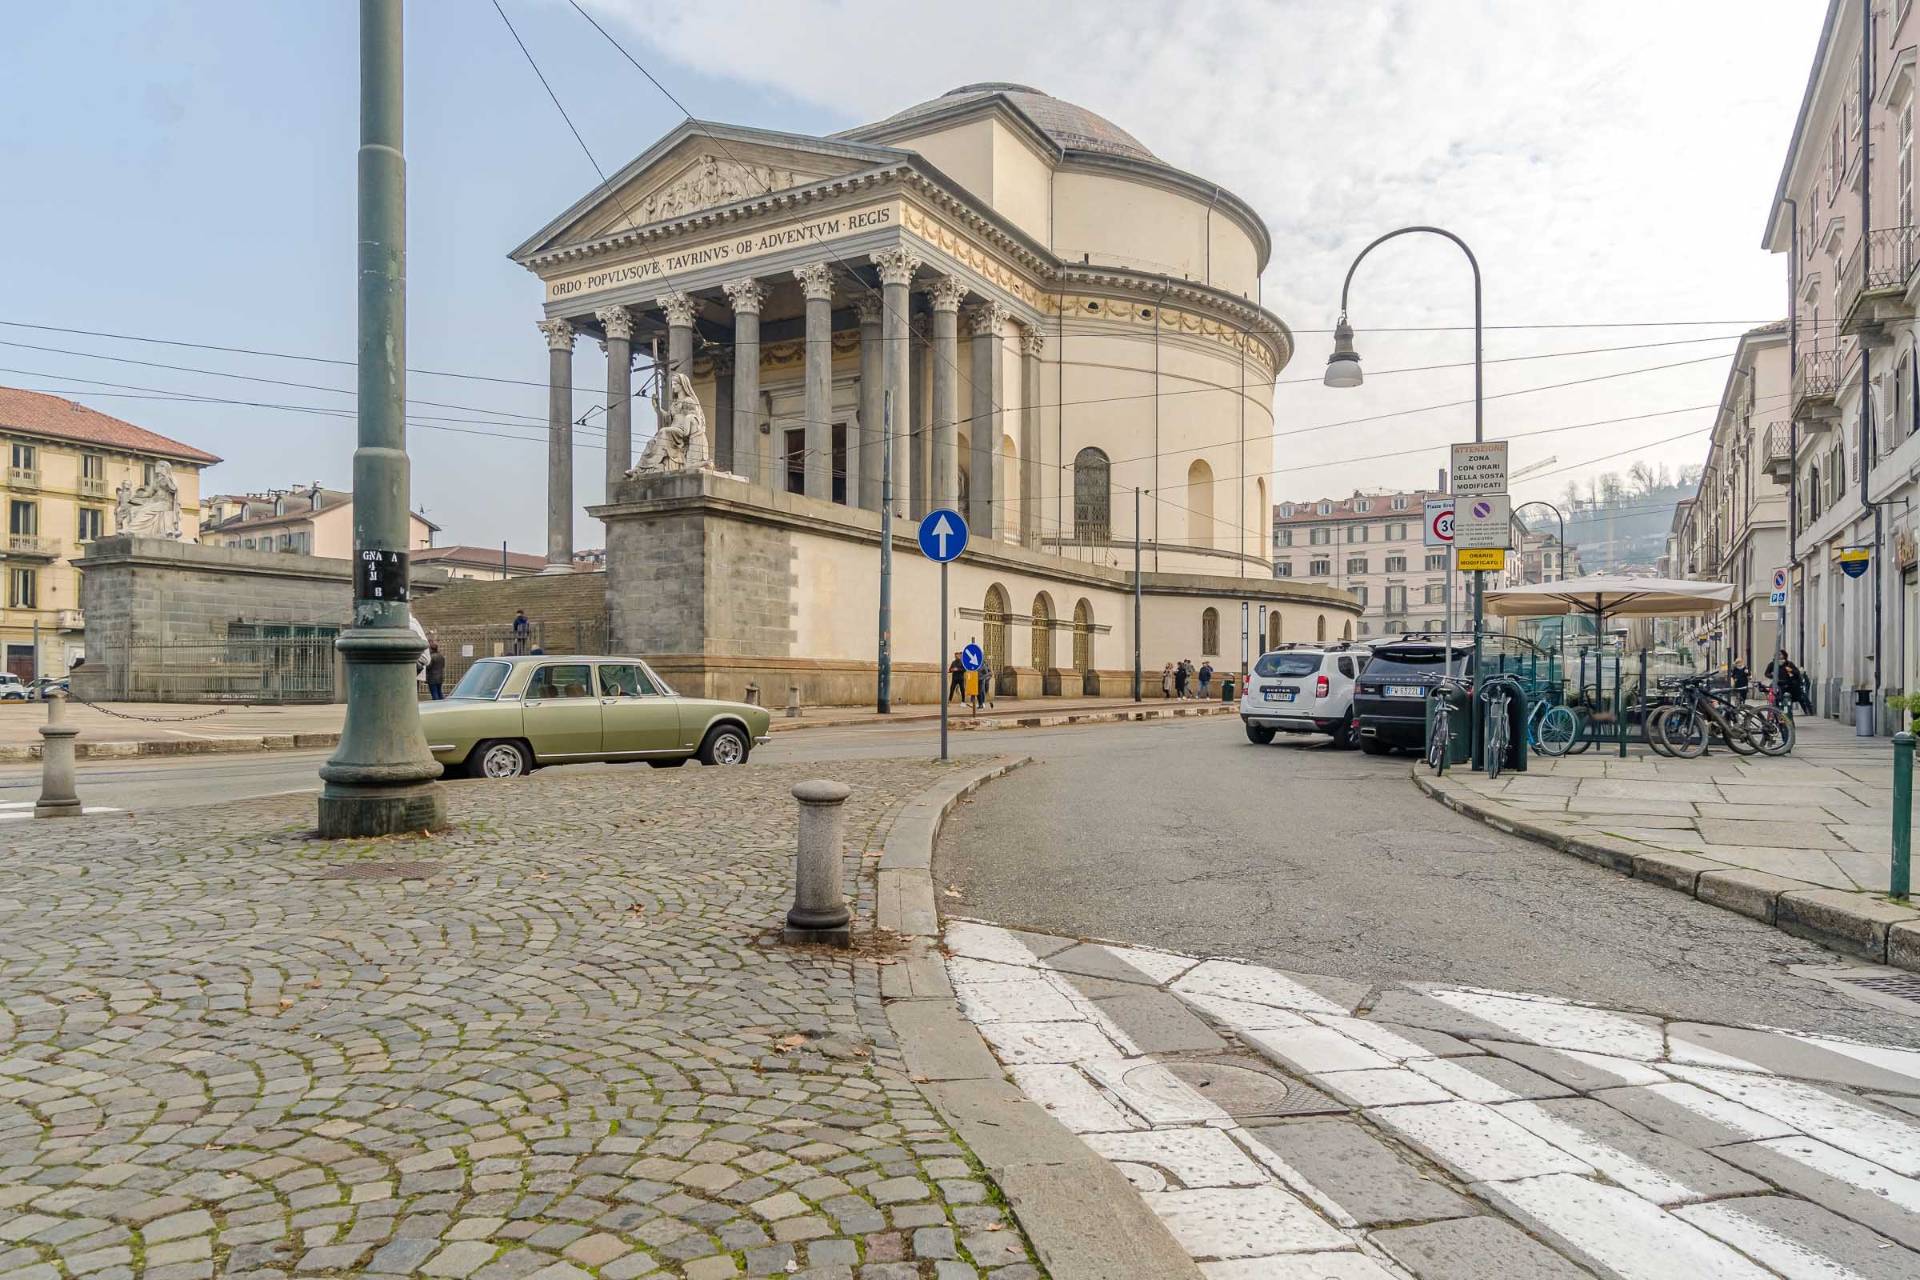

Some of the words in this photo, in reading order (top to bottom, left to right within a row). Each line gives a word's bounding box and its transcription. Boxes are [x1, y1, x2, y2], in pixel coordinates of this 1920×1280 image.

[552, 280, 582, 296] ORDO
[666, 245, 729, 271] TAVRINVS
[736, 240, 752, 254] OB
[758, 219, 840, 250] ADVENTVM
[848, 208, 890, 230] REGIS
[1476, 463, 1500, 471] ORARI
[1457, 482, 1501, 490] MODIFICATI
